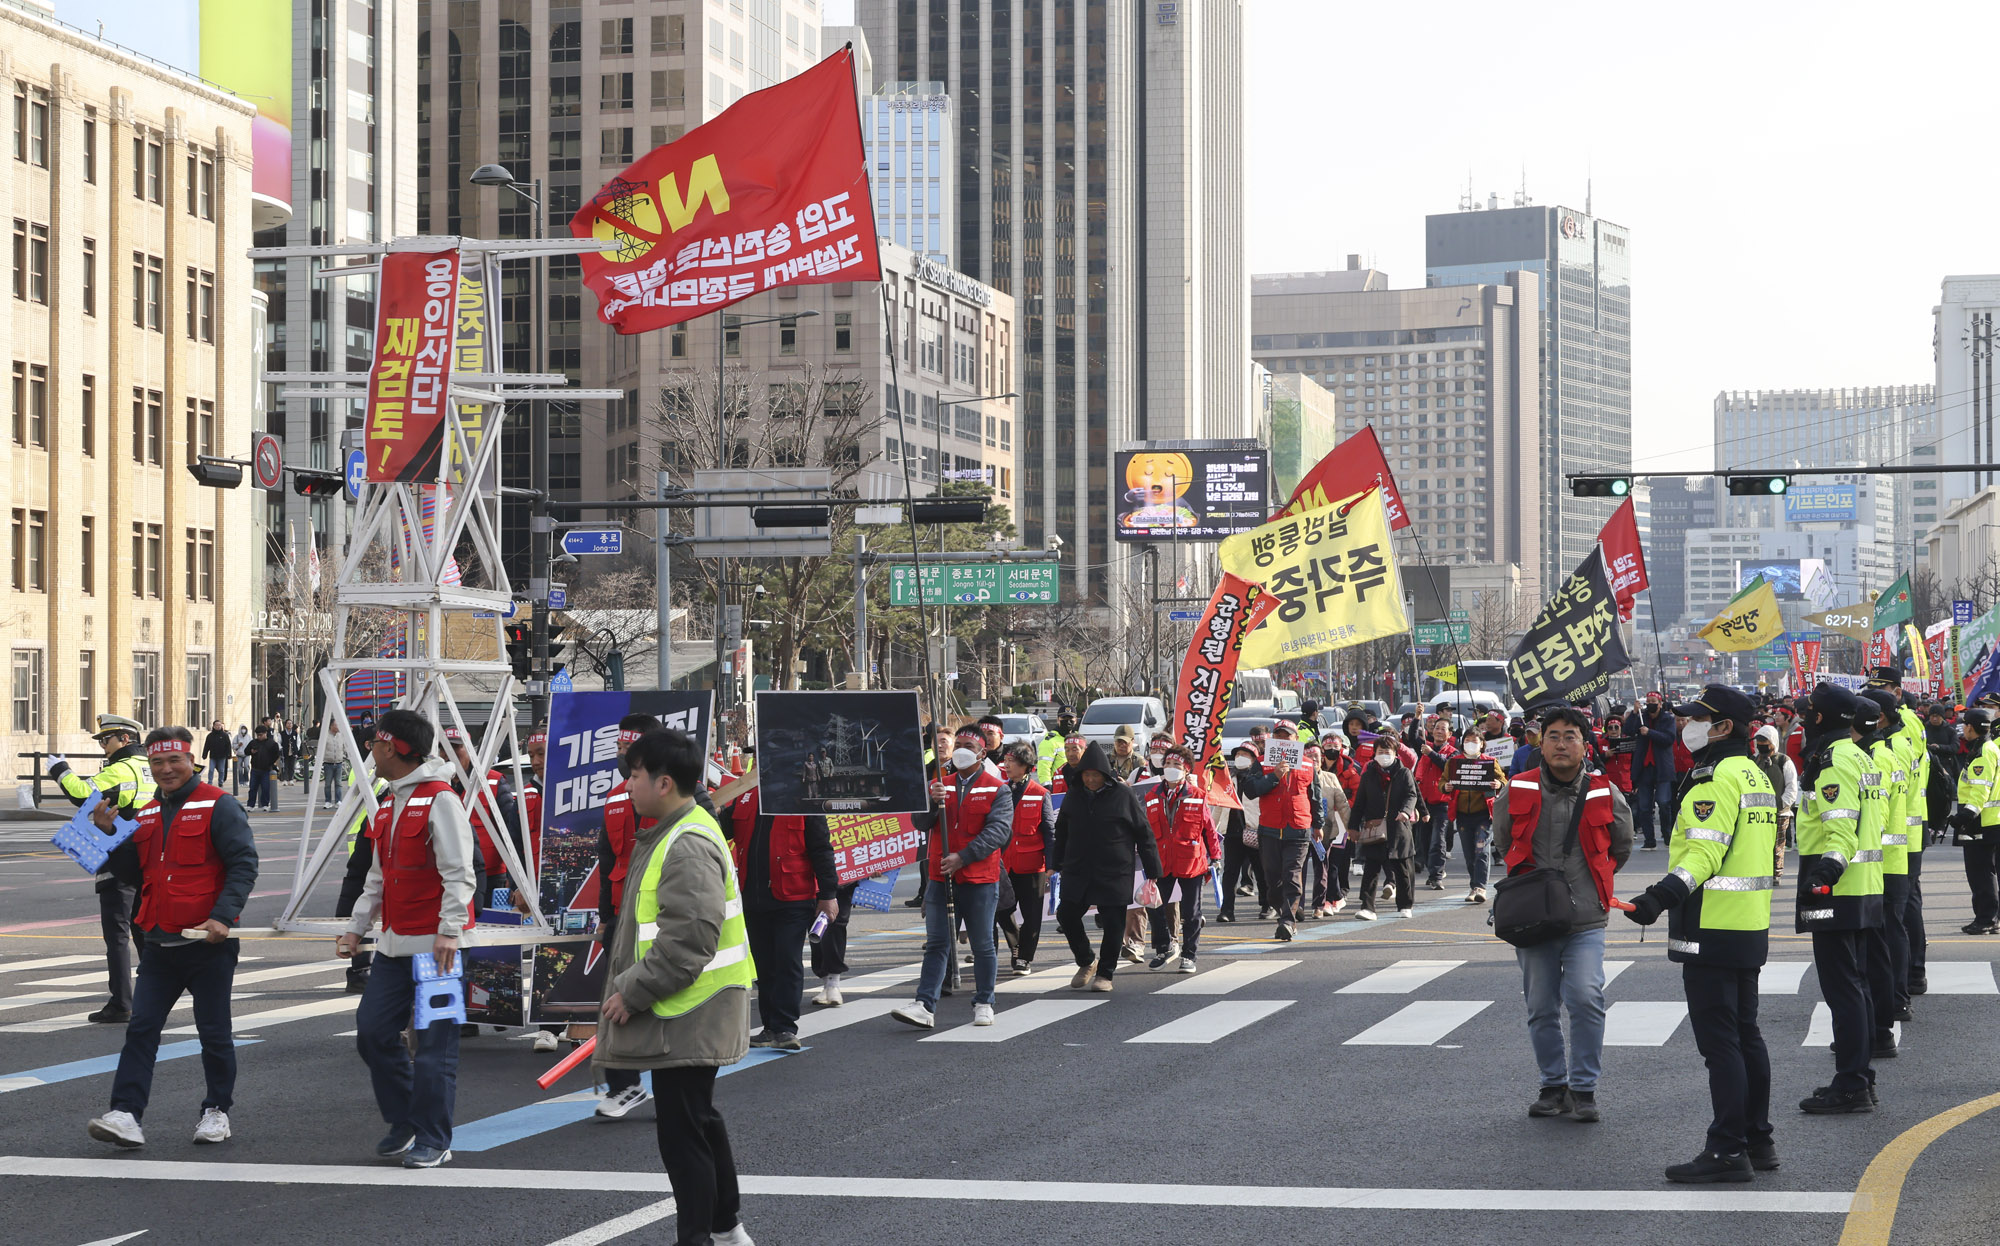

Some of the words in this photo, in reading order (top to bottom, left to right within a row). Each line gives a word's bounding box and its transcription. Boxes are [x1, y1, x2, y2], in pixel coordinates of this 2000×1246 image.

[411, 258, 453, 414] 용인산단
[370, 318, 420, 474] 재검토!
[1787, 493, 1854, 510] 기프트인포
[600, 533, 618, 543] 종로
[592, 544, 619, 552] Jong-ro
[908, 567, 940, 578] 숭례문
[951, 568, 996, 579] 종로1가
[1008, 569, 1053, 580] 서대문역
[952, 581, 975, 589] Jongno
[1825, 613, 1869, 628] 62기-3
[1183, 668, 1221, 761] 지역발전
[851, 830, 927, 866] 철회하라!
[840, 870, 866, 881] 영암군
[866, 855, 906, 874] 대책위원회
